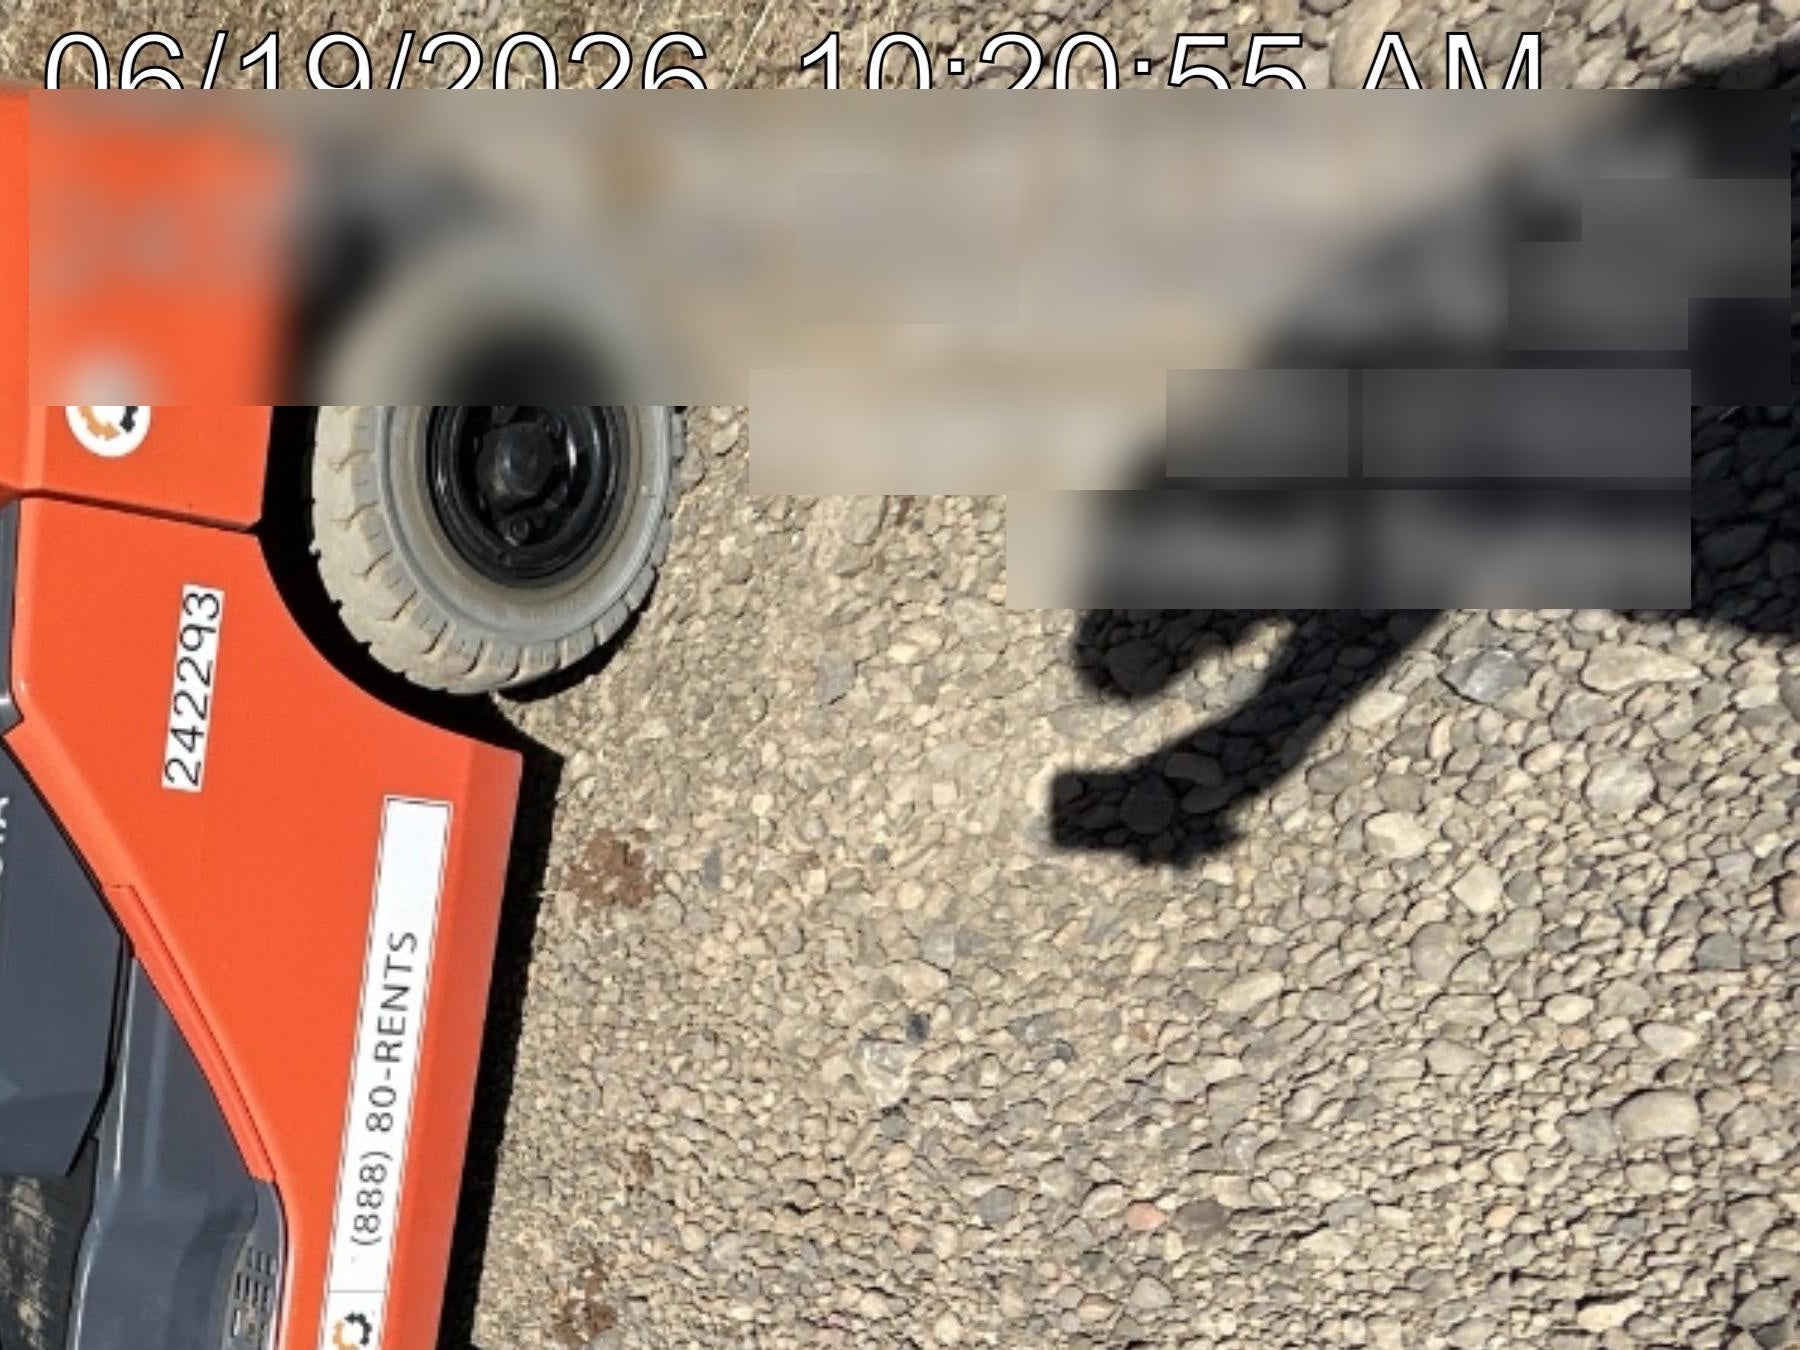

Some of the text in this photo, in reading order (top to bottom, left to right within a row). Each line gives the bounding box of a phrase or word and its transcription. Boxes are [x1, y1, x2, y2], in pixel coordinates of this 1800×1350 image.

[166, 592, 220, 786] 242293
[350, 932, 417, 1246] (888) 80-RENTS
